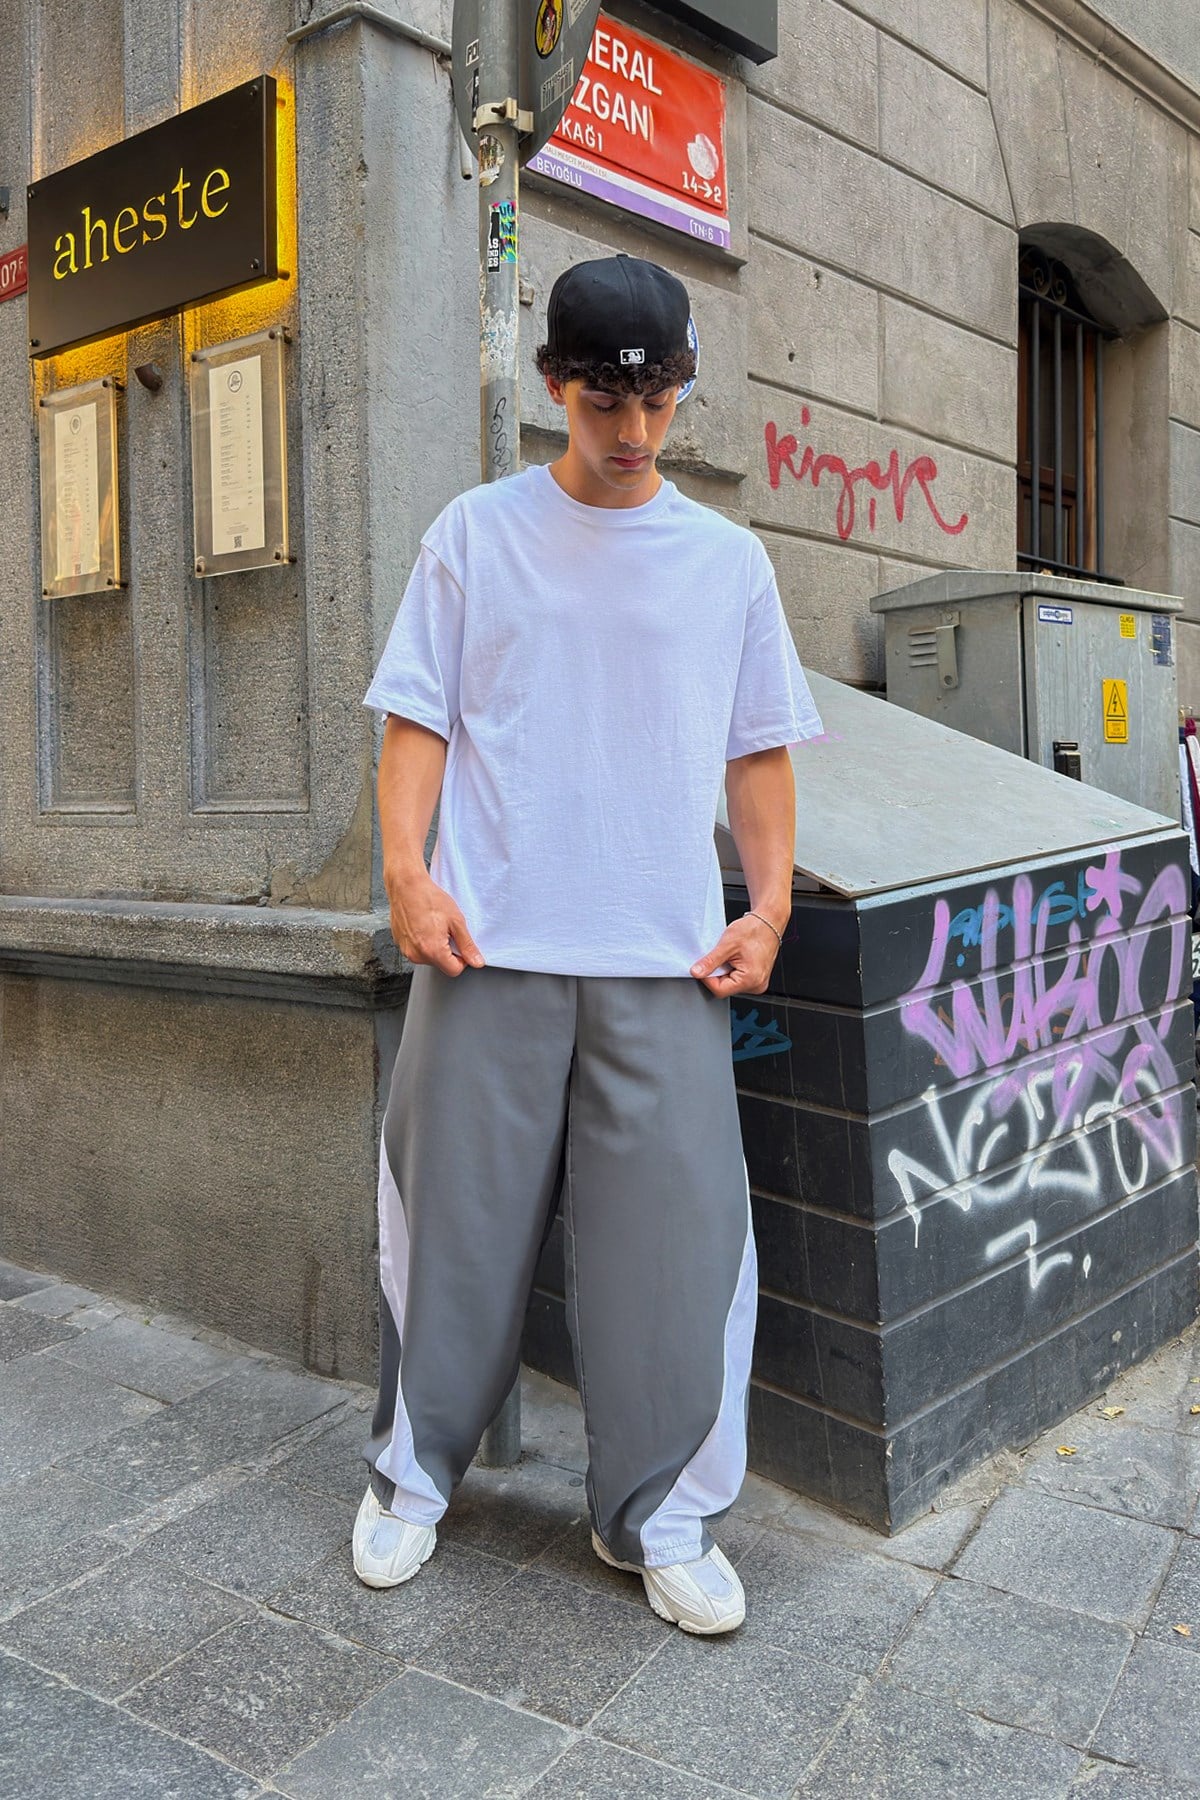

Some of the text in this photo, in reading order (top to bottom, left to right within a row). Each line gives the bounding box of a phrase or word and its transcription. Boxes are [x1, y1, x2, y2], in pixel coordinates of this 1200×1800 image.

[555, 115, 602, 151] KAĞI
[570, 75, 649, 141] ZGAN
[536, 156, 582, 187] BEYOĞLU
[53, 167, 231, 280] aheste
